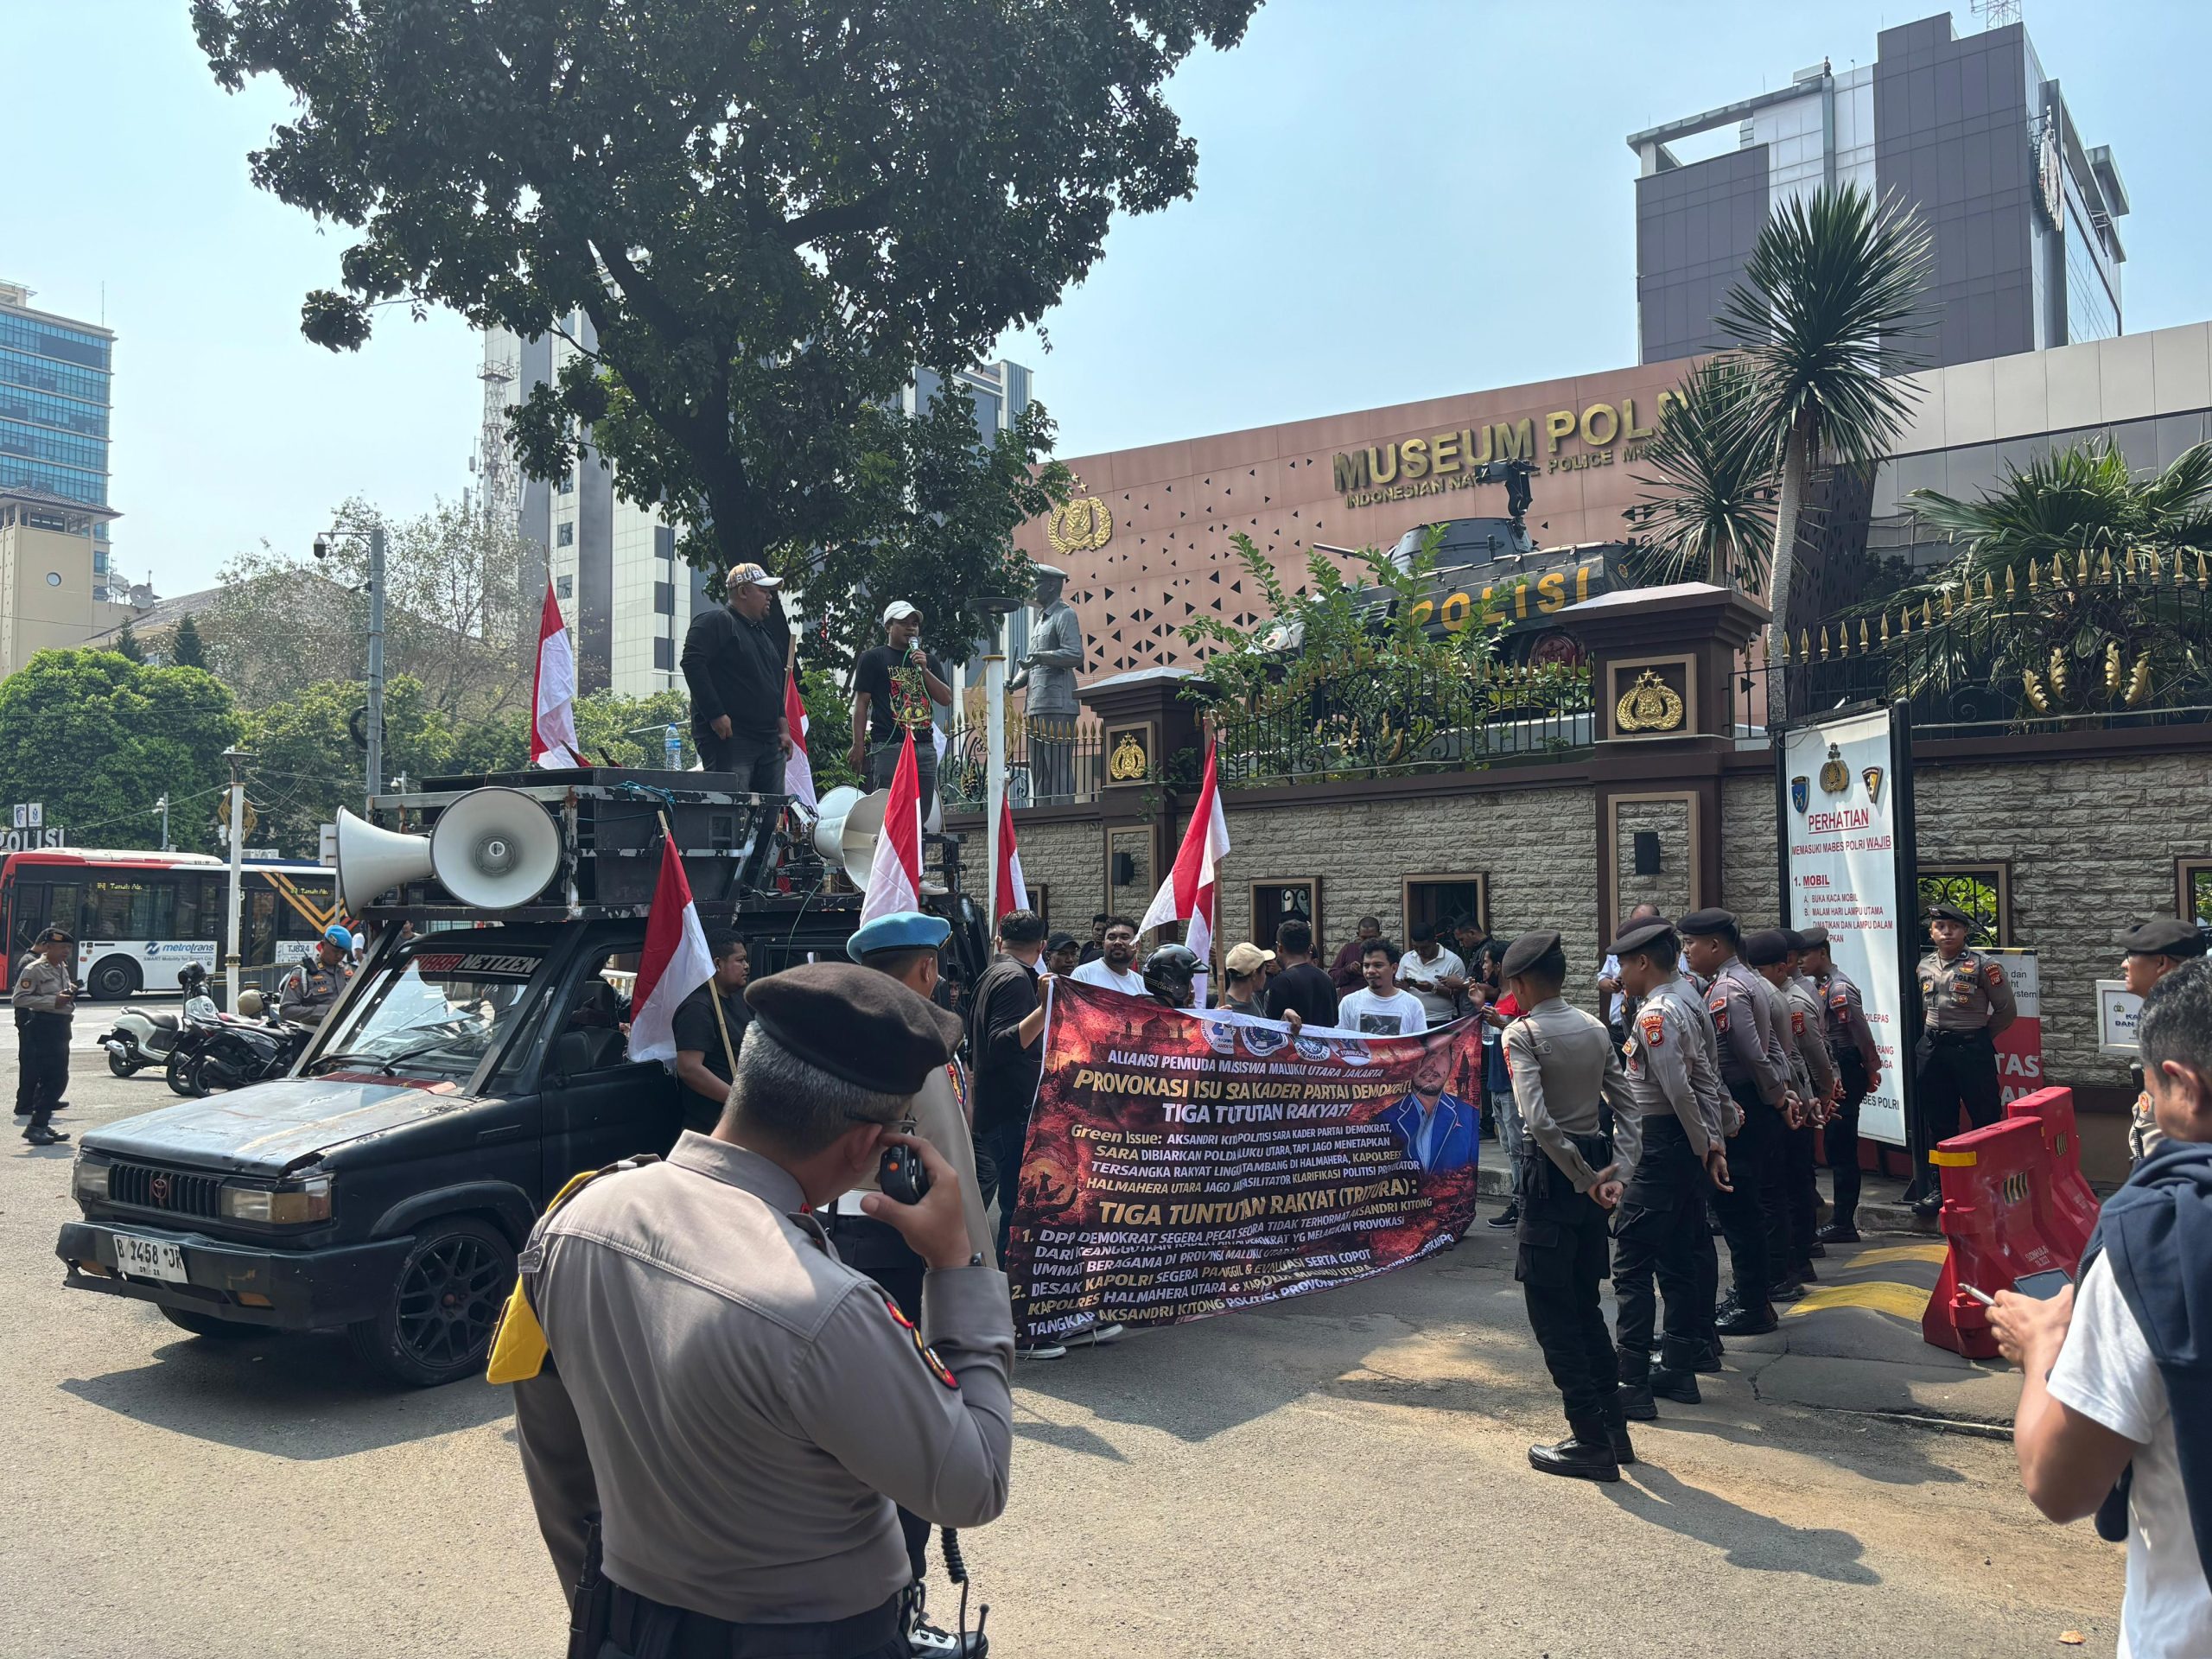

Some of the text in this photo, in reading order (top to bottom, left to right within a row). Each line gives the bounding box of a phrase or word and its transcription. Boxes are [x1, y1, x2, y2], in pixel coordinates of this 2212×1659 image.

[1332, 418, 1533, 492] MUSEUM
[1548, 449, 1613, 474] POLICE
[1345, 479, 1446, 509] INDONESIAN
[1808, 808, 1869, 831] PERHATIAN
[1792, 835, 1891, 855] MEMASUKI MABES POLRI WAJIB
[1794, 874, 1830, 887] 1. MOBIL
[1864, 906, 1884, 915] UTAMA
[1853, 920, 1872, 929] LAMPU
[1872, 920, 1893, 929] DALAM
[162, 944, 214, 954] metrotrans
[457, 954, 543, 973] NETIZEN
[1108, 1050, 1158, 1068] ALIANSI
[1161, 1056, 1216, 1071] PEMUDA
[1268, 1064, 1306, 1076] MALUKU
[1307, 1065, 1342, 1077] UTARA
[1343, 1068, 1384, 1078] JAKARTA
[1073, 1069, 1189, 1097] PROVOKASI
[1193, 1080, 1222, 1099] ISU
[1252, 1082, 1301, 1099] KADER
[1303, 1084, 1350, 1101] PARTAI
[1162, 1103, 1211, 1123] TIGA
[1287, 1103, 1354, 1120] RAKYAT!
[1878, 1096, 1899, 1111] POLRI
[1071, 1124, 1122, 1143] Green
[1126, 1130, 1162, 1144] Issue:
[1166, 1134, 1218, 1145] AKSANDRI
[1238, 1132, 1271, 1143] POLITISI
[1272, 1130, 1291, 1141] SARA
[1292, 1128, 1316, 1139] KADER
[1317, 1126, 1343, 1137] PARTAI
[1345, 1123, 1392, 1135] DEMOKRAT,
[1094, 1145, 1139, 1160] SARA
[1141, 1149, 1202, 1161] DIBIARKAN
[1204, 1150, 1236, 1161] POLDA
[1265, 1144, 1292, 1157] UTARA,
[1292, 1142, 1310, 1154] TAPI
[1312, 1141, 1332, 1152] JAGO
[1334, 1137, 1390, 1149] MENETAPKAN
[1091, 1160, 1171, 1177] TERSANGKA
[1173, 1166, 1211, 1177] RAKYAT
[1242, 1160, 1287, 1173] TAMBANG
[1289, 1159, 1299, 1169] DI
[1300, 1154, 1351, 1167] HALMAHERA,
[1086, 1178, 1168, 1194] HALMAHERA
[1171, 1182, 1202, 1193] UTARA
[1204, 1182, 1231, 1193] JAGO
[1292, 1168, 1340, 1184] KLARIFIKASI
[1343, 1166, 1376, 1178] POLITISI
[1098, 1201, 1162, 1226] TIGA
[1269, 1188, 1336, 1215] RAKYAT
[1022, 1230, 1033, 1243] 1.
[1077, 1231, 1158, 1244] DEMOKRAT
[1159, 1231, 1203, 1243] SEGERA
[1205, 1229, 1237, 1242] PECAT
[1268, 1218, 1297, 1232] TIDAK
[1300, 1211, 1350, 1228] TERHORMAT
[1401, 1197, 1433, 1211] KITONG
[117, 1239, 124, 1258] B
[1034, 1245, 1074, 1261] DARI
[1293, 1231, 1306, 1243] YG
[1353, 1216, 1405, 1231] PROVOKASI
[1011, 1249, 1371, 1300] 2. DESAK KAPOLRI SEGERA PANGGIL & EVALUASI SERTA COPOT
[1033, 1262, 1084, 1276] UMMAT
[1086, 1256, 1162, 1272] BERAGAMA
[1165, 1254, 1176, 1266] DI
[1027, 1293, 1101, 1315] KAPOLRES
[1103, 1287, 1188, 1303] HALMAHERA
[1191, 1282, 1226, 1296] UTARA
[1229, 1283, 1240, 1293] &
[1028, 1311, 1096, 1336] TANGKAP
[1098, 1304, 1173, 1321] AKSANDRI
[1177, 1299, 1225, 1315] KITONG
